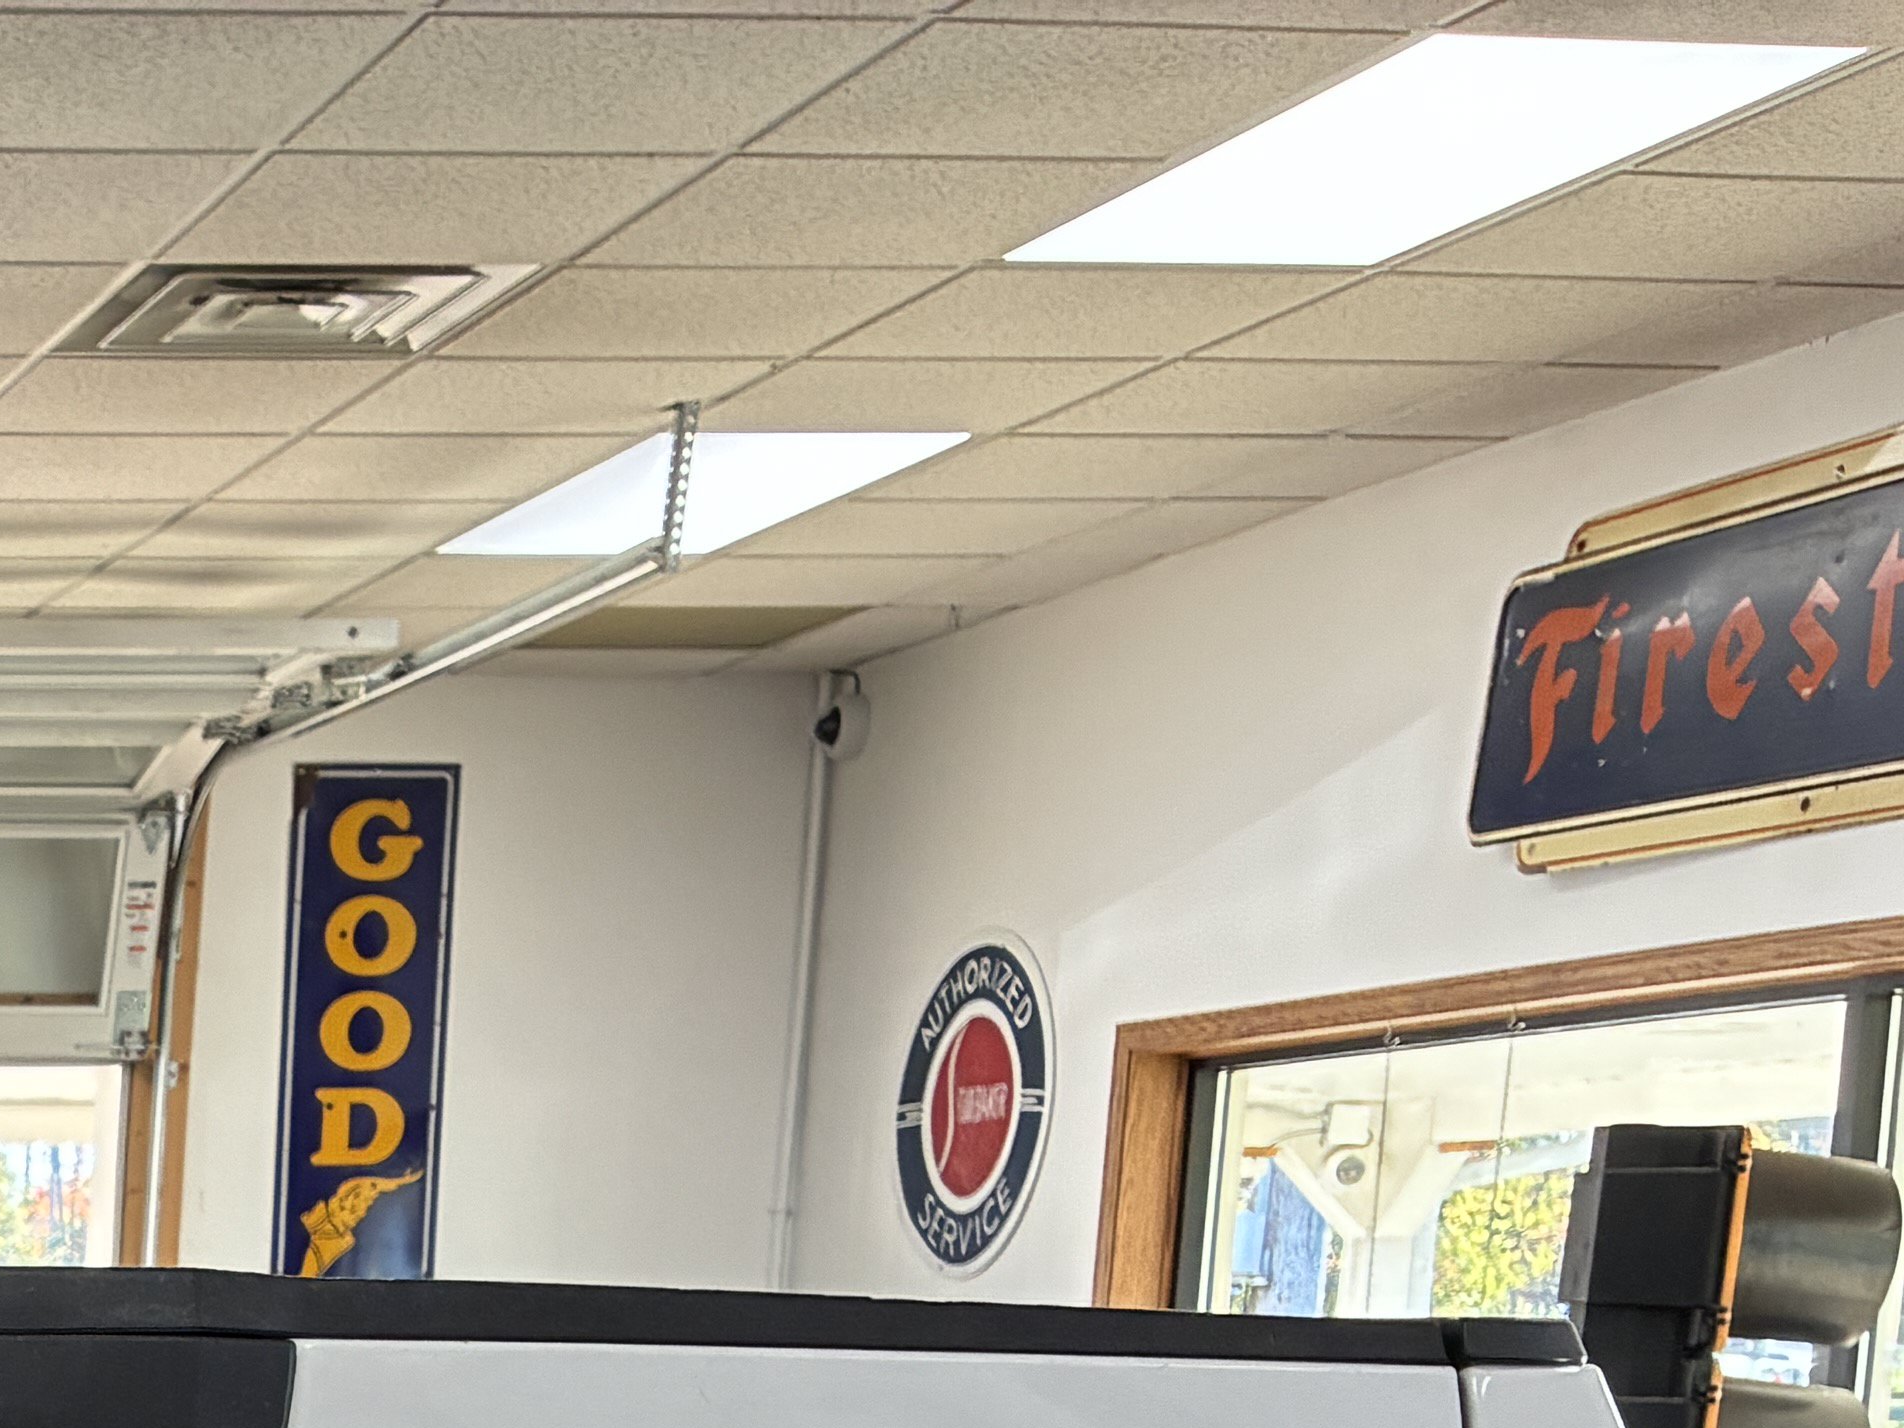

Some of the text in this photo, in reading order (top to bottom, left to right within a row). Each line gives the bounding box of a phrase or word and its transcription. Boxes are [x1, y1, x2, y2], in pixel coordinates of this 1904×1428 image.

[308, 798, 425, 1167] GOOD
[919, 956, 1033, 1051] AUTHORIZED
[917, 1176, 1013, 1258] SERVICE
